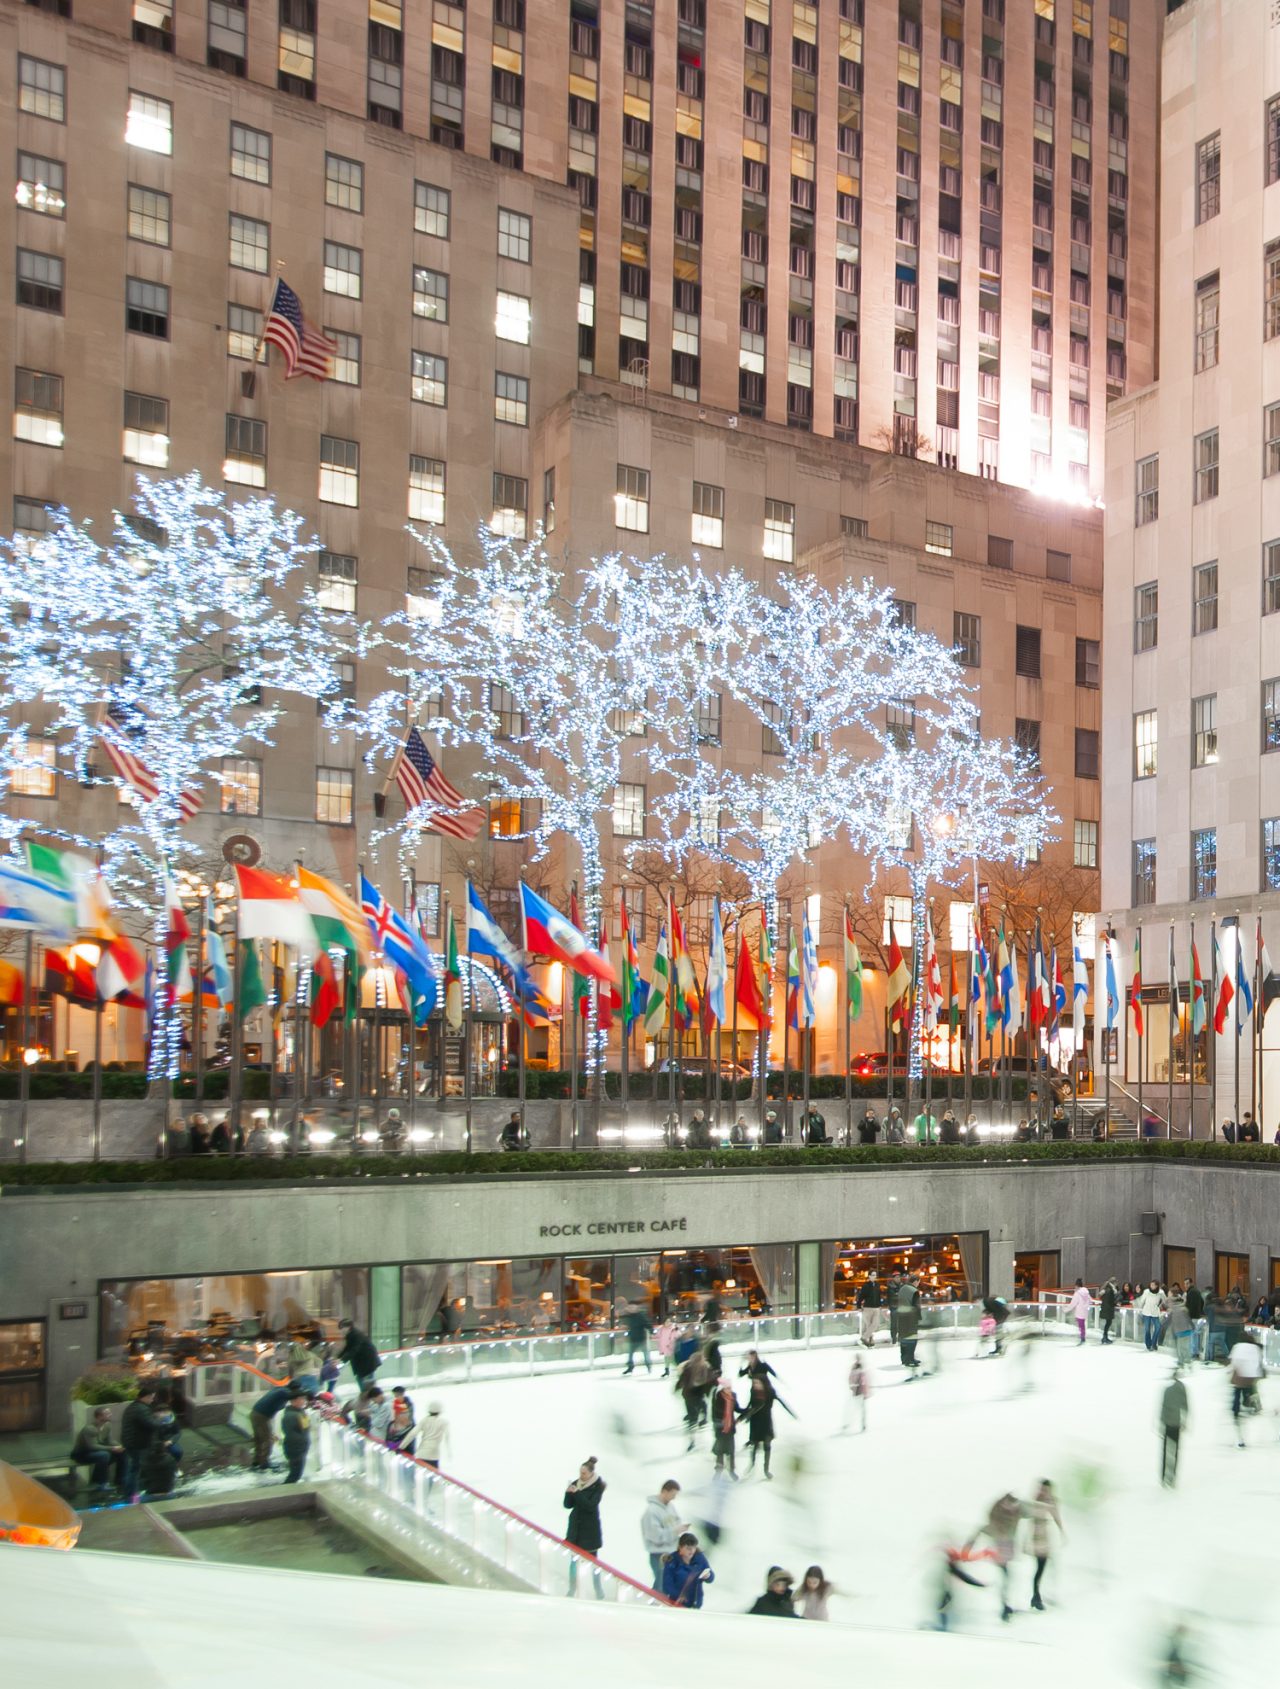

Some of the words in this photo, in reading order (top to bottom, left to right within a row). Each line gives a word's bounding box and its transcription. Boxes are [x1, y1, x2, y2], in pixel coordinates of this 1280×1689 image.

[539, 1224, 582, 1237] ROCK
[587, 1221, 645, 1235] CENTER
[650, 1217, 688, 1232] CAFÉ
